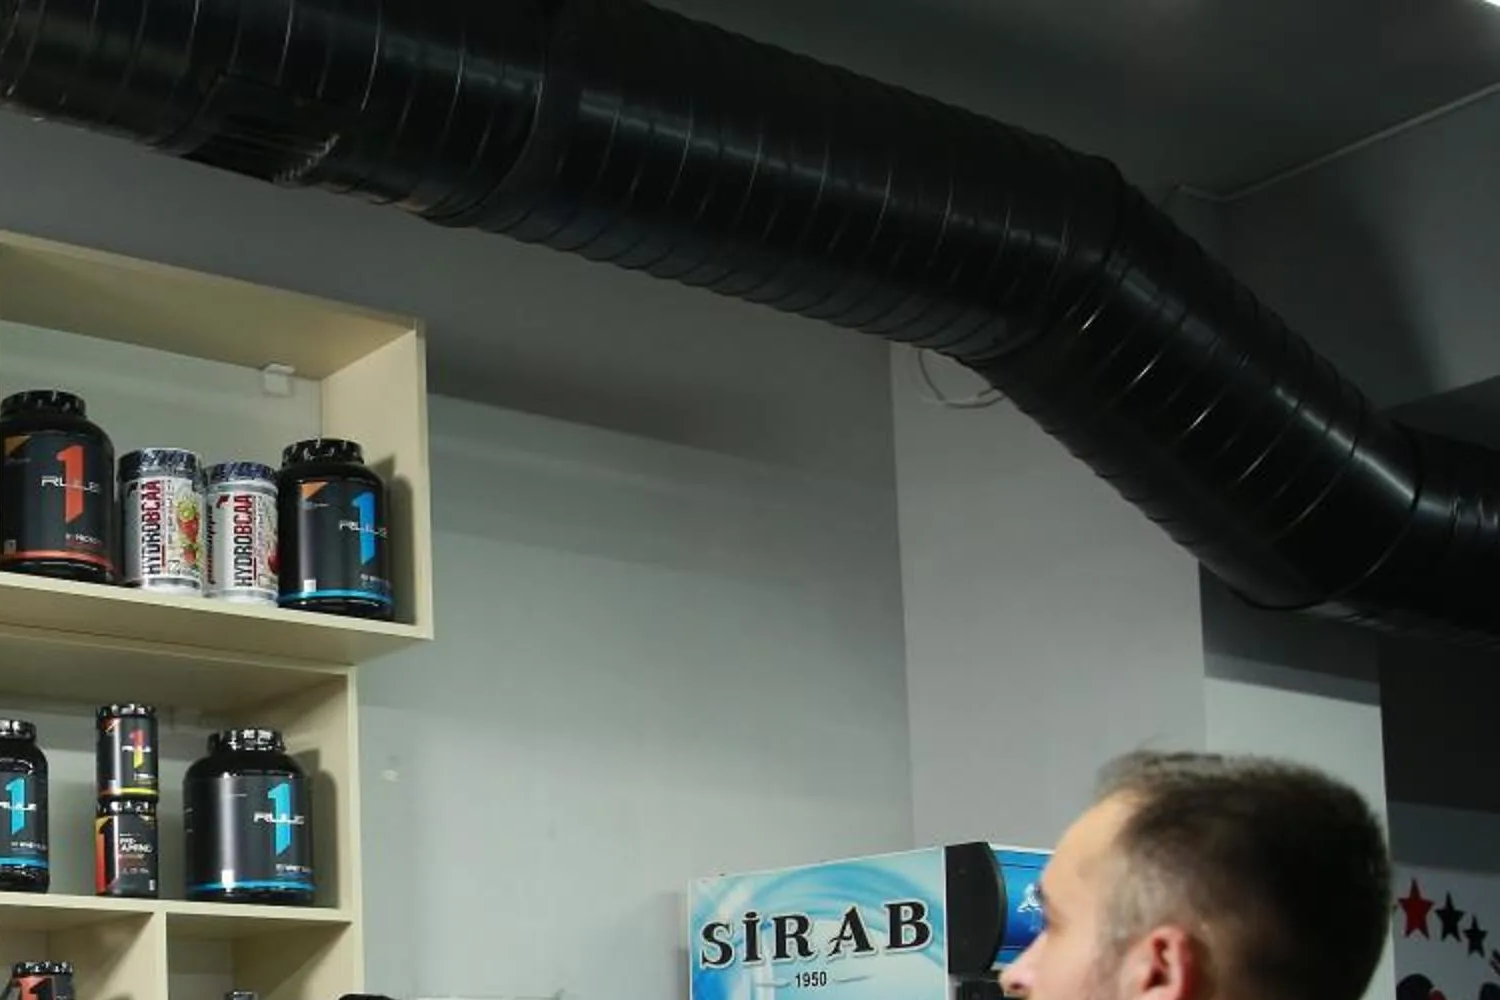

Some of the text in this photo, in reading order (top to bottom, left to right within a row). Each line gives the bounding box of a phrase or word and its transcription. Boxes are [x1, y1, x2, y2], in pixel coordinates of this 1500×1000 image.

[141, 479, 161, 576] HYDROBCAA
[233, 494, 253, 588] HYDROBCAA
[700, 901, 932, 967] SİRAB
[795, 971, 828, 988] 1950
